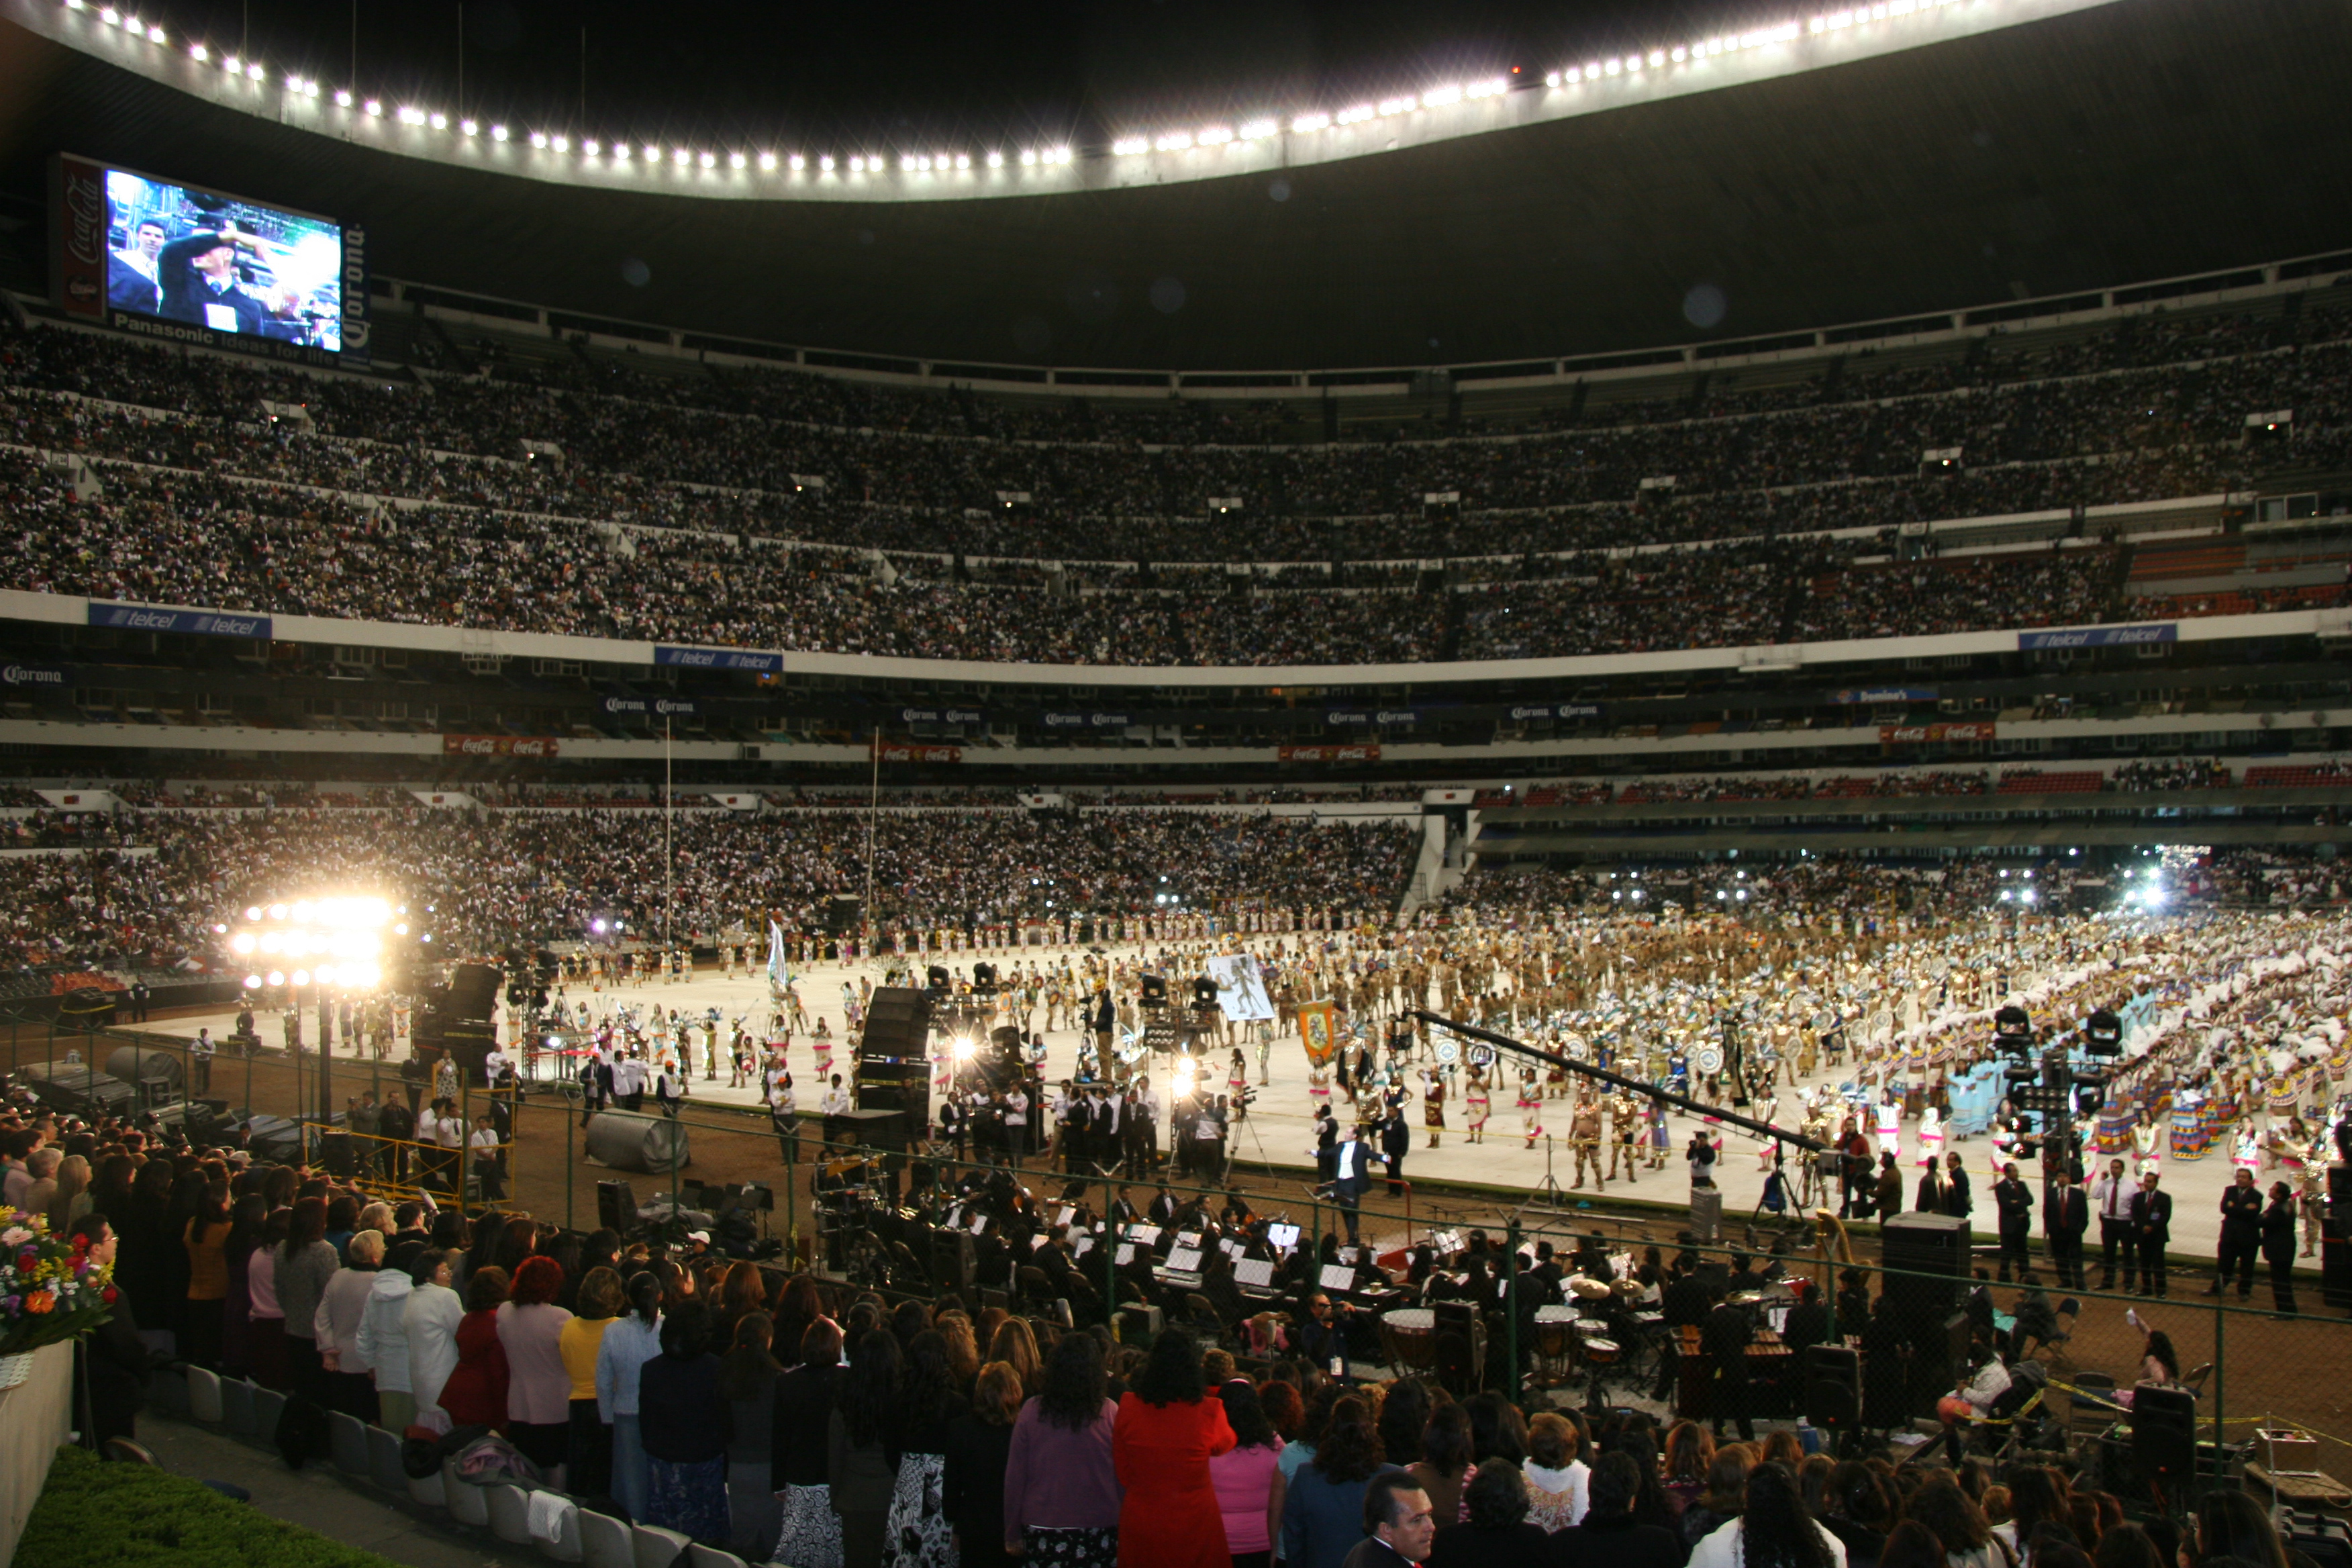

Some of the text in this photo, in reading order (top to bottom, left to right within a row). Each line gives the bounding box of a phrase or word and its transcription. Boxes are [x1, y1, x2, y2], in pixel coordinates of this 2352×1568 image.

[341, 229, 371, 348] Corona
[115, 313, 334, 365] Panasonic ideas for life
[127, 611, 258, 635] telcel telcel
[2047, 627, 2163, 647] telcel telcel
[681, 652, 773, 669] telcel telcel
[3, 665, 62, 685] Corona
[606, 697, 693, 714] Corona Corona
[1510, 704, 1598, 720] Corona Corona
[903, 708, 980, 723] Corona Corona
[1045, 712, 1128, 726] Corona Corona
[1328, 710, 1415, 725] Corona Corona
